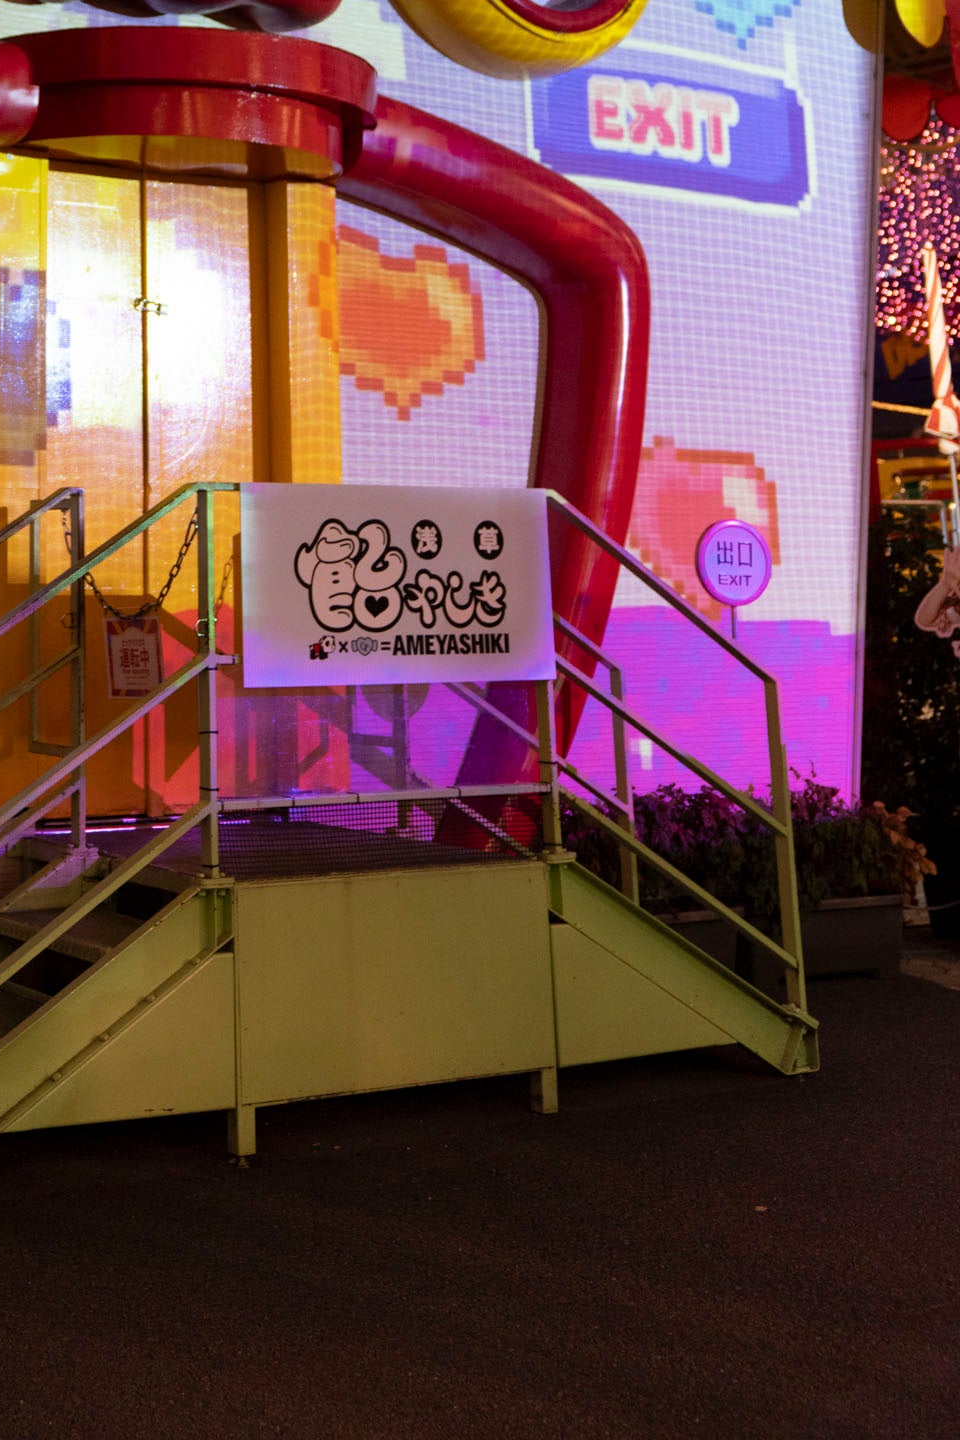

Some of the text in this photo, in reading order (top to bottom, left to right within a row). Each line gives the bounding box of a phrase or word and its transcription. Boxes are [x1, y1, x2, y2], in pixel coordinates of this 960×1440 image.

[588, 74, 740, 168] EXIT
[413, 523, 502, 557] 浅 草
[717, 541, 752, 567] 出口
[294, 518, 507, 632] 飴やしき
[718, 574, 752, 586] EXIT
[392, 633, 510, 656] AMEYASHIKI
